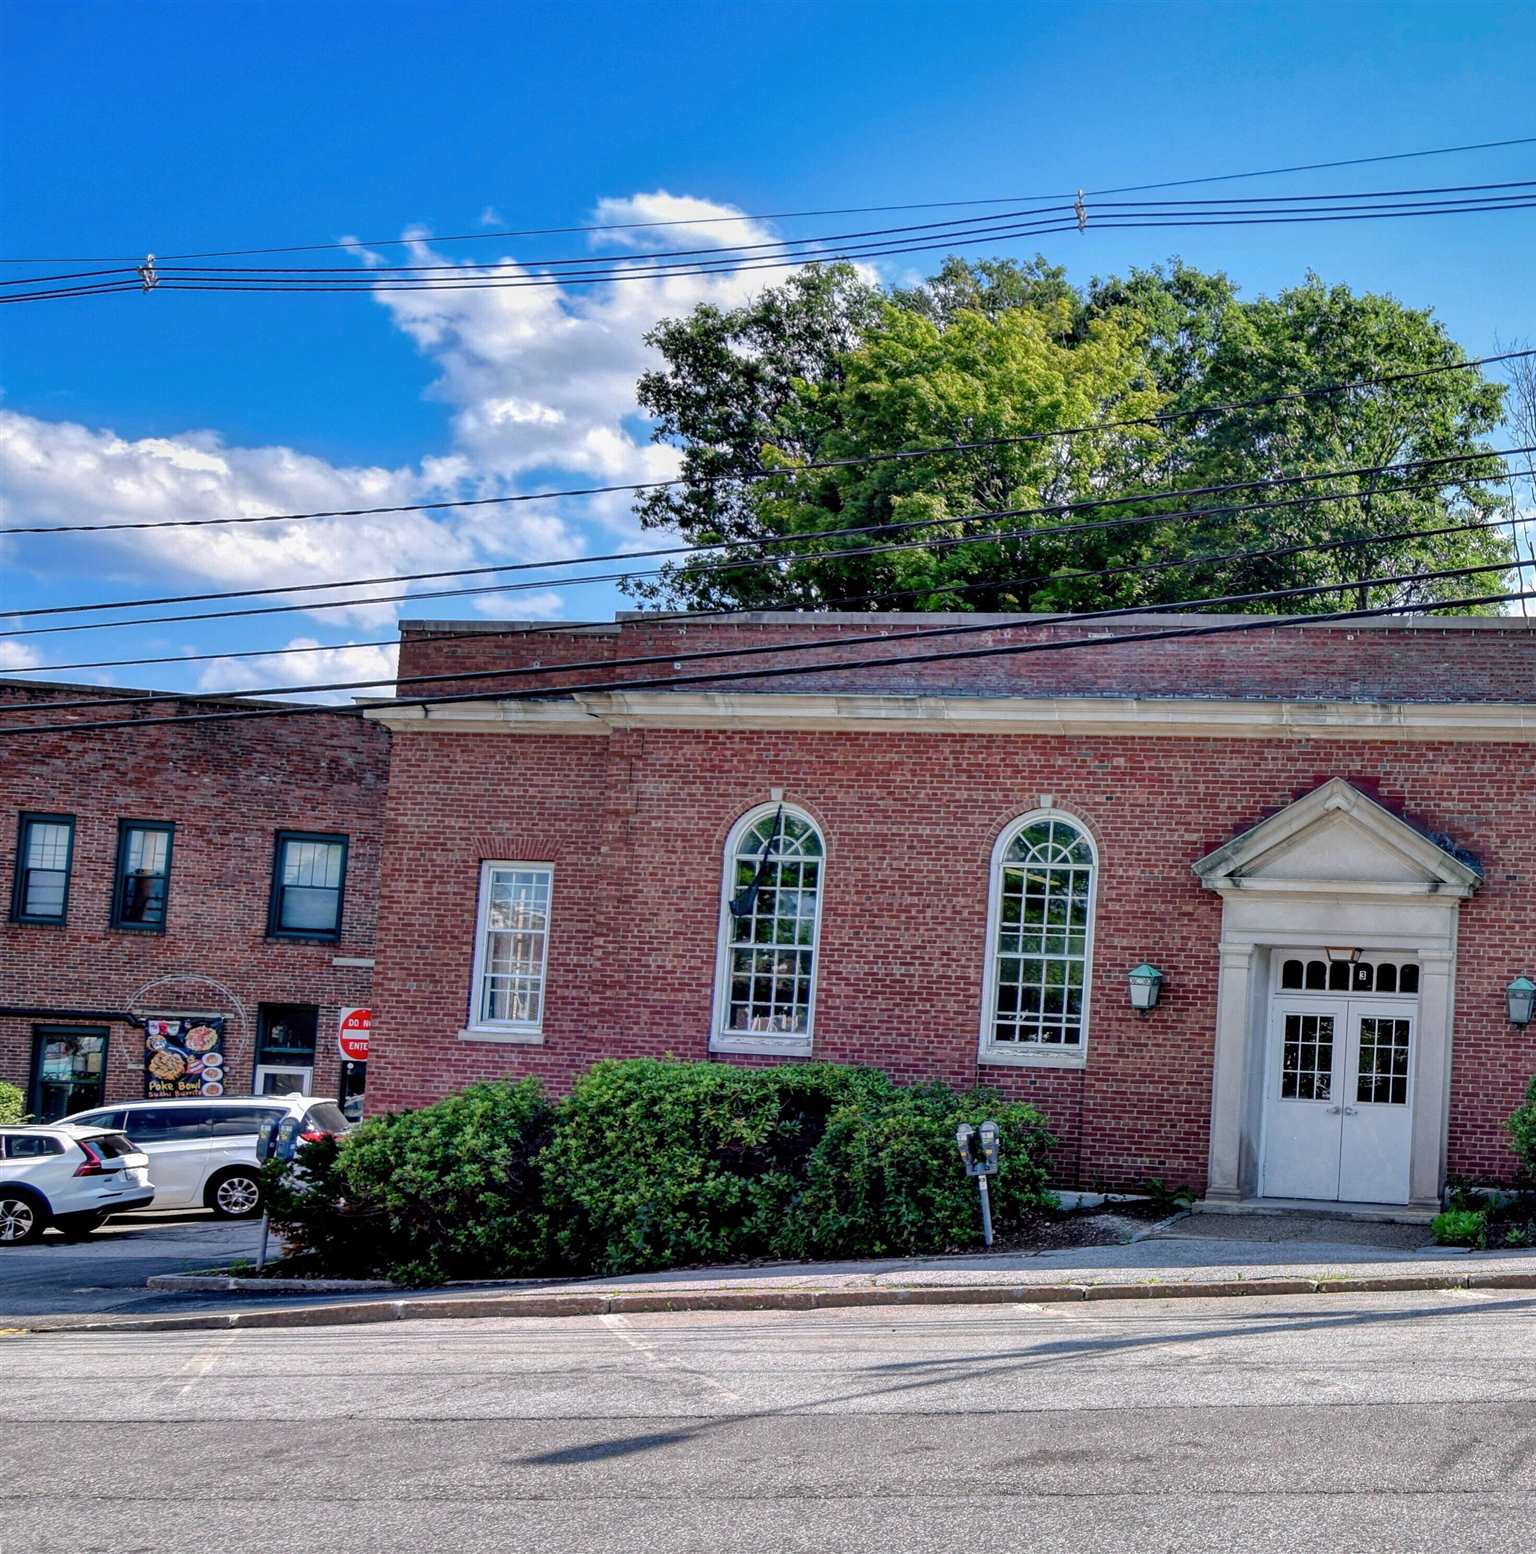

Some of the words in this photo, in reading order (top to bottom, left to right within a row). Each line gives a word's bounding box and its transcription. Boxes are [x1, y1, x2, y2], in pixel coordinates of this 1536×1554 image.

[349, 1019, 359, 1027] DO
[149, 1080, 174, 1091] Poke
[178, 1079, 201, 1090] Bowl
